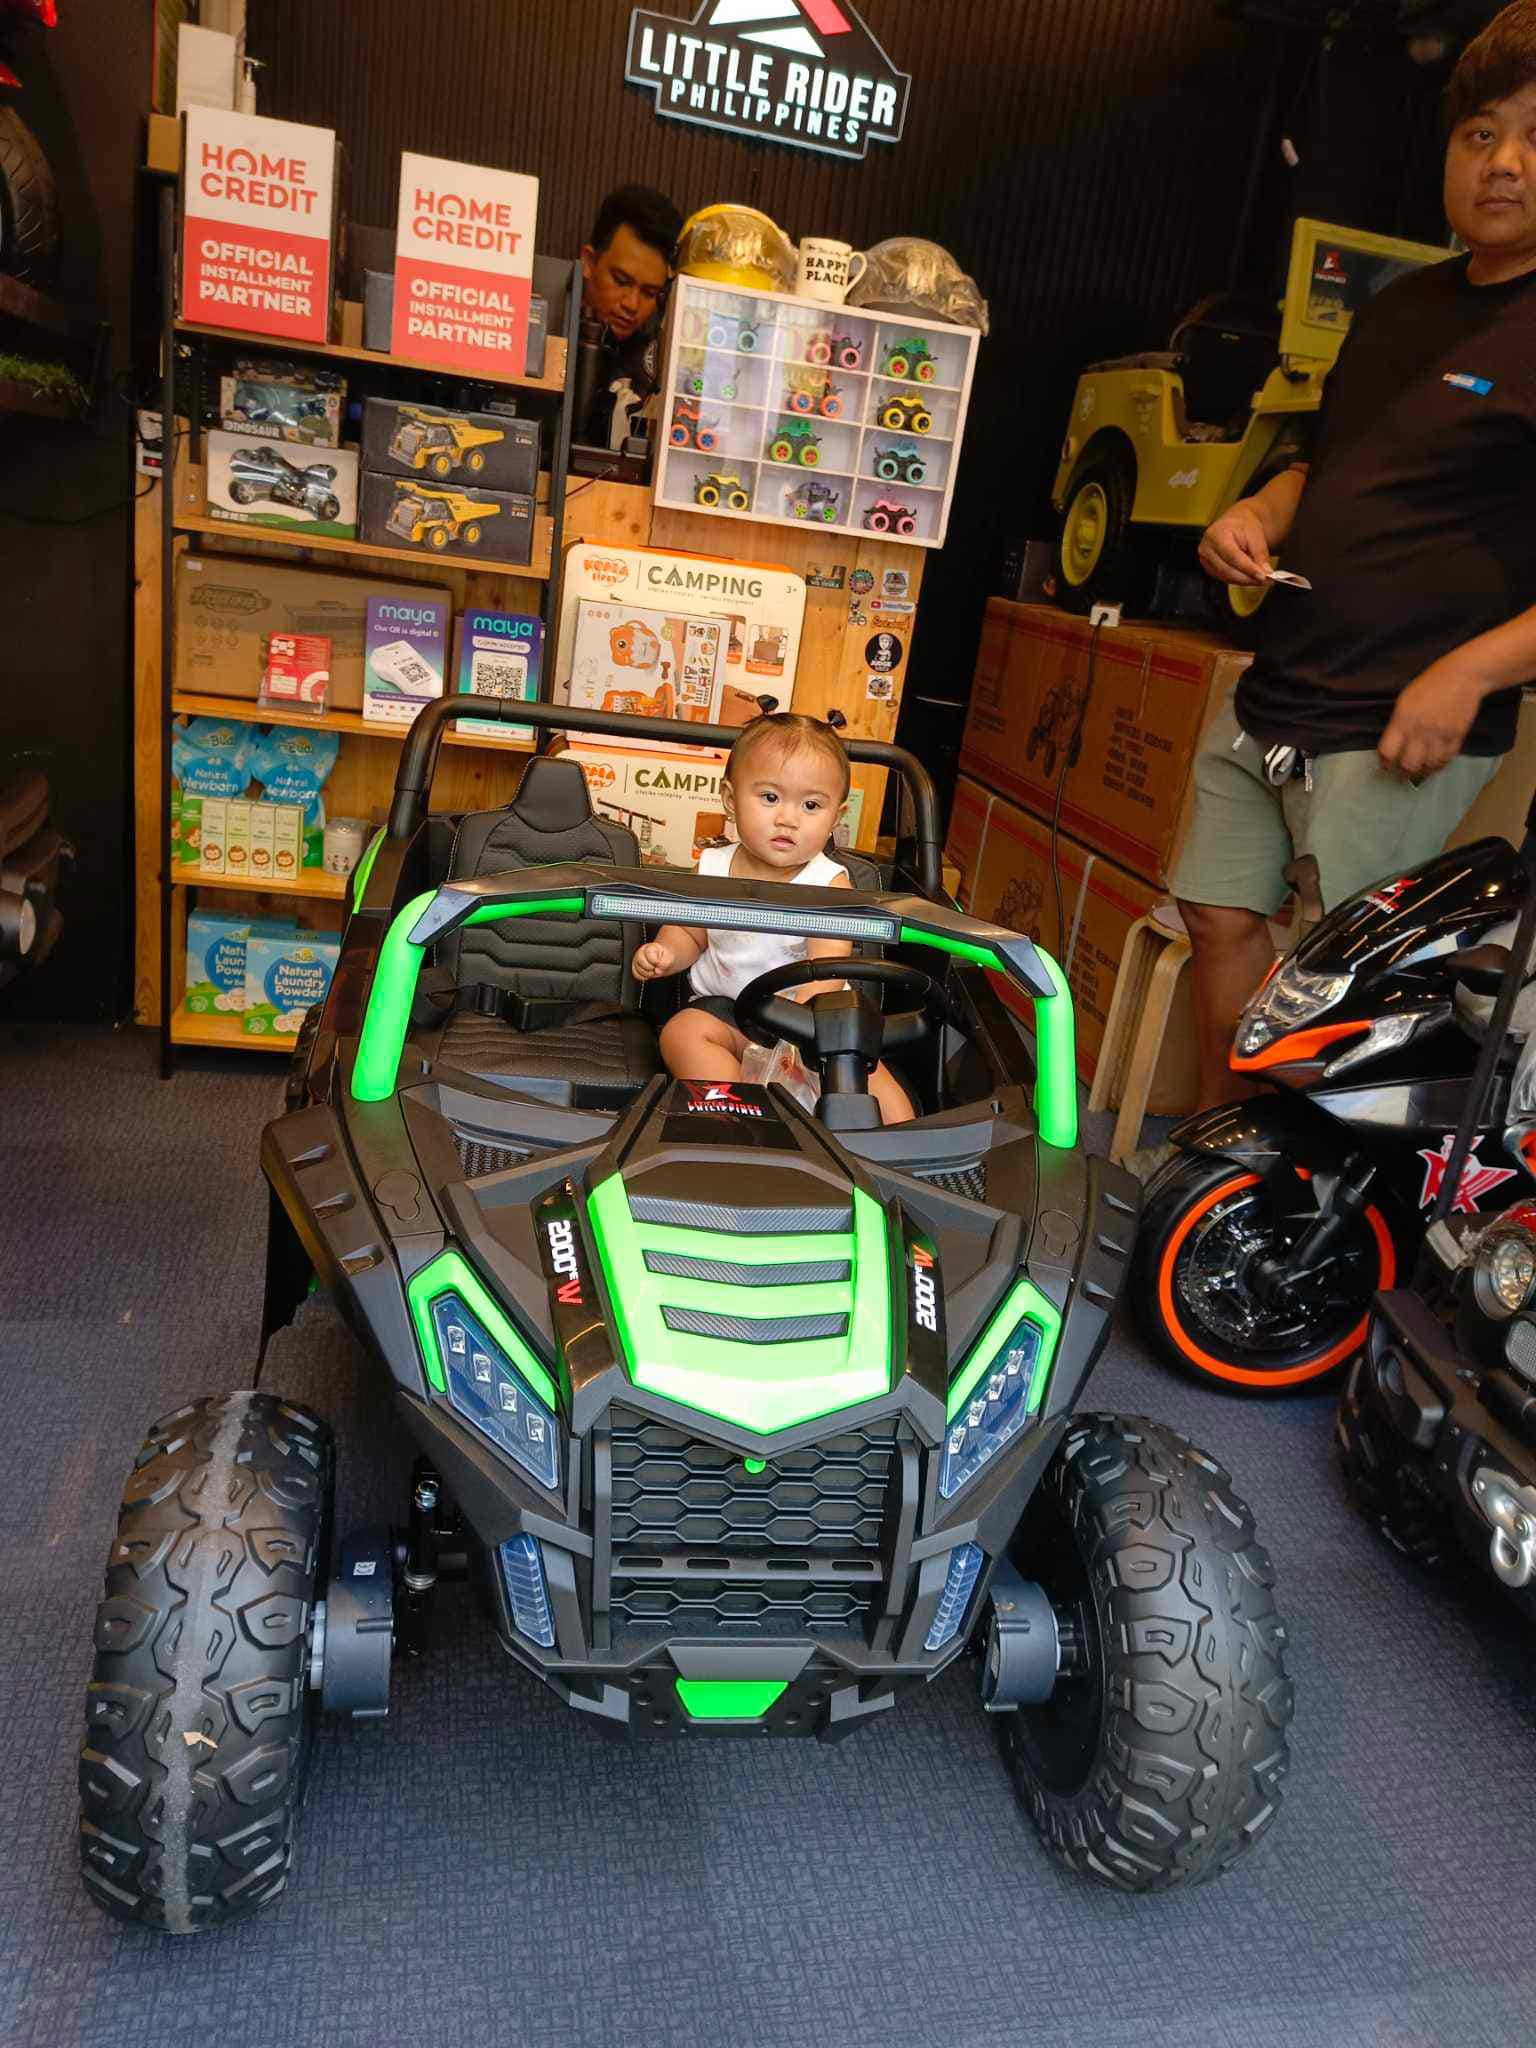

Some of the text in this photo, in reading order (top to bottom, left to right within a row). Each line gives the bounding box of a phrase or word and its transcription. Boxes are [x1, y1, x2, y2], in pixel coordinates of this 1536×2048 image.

[639, 26, 897, 127] LITTLE RIDER
[670, 79, 860, 144] PHILIPPINES
[201, 142, 307, 184] HOME
[200, 172, 318, 214] CREDIT
[414, 188, 512, 227] HOME
[412, 216, 522, 255] CREDIT
[200, 239, 313, 276] OFFICIAL
[200, 263, 312, 293] INSTALLMENT
[199, 280, 312, 316] PARTNER
[410, 278, 515, 313] OFFICIAL
[409, 301, 513, 329] INSTALLMENT
[407, 317, 512, 351] PARTNER
[647, 563, 763, 599] CAMPING
[379, 604, 436, 626] maya
[473, 616, 533, 639] maya
[183, 776, 239, 793] Newborn
[634, 766, 722, 795] CAMPI
[215, 953, 244, 966] Laun
[219, 944, 246, 956] Natu
[274, 975, 326, 990] Laundry
[279, 964, 323, 978] Natural
[275, 985, 324, 998] Powder
